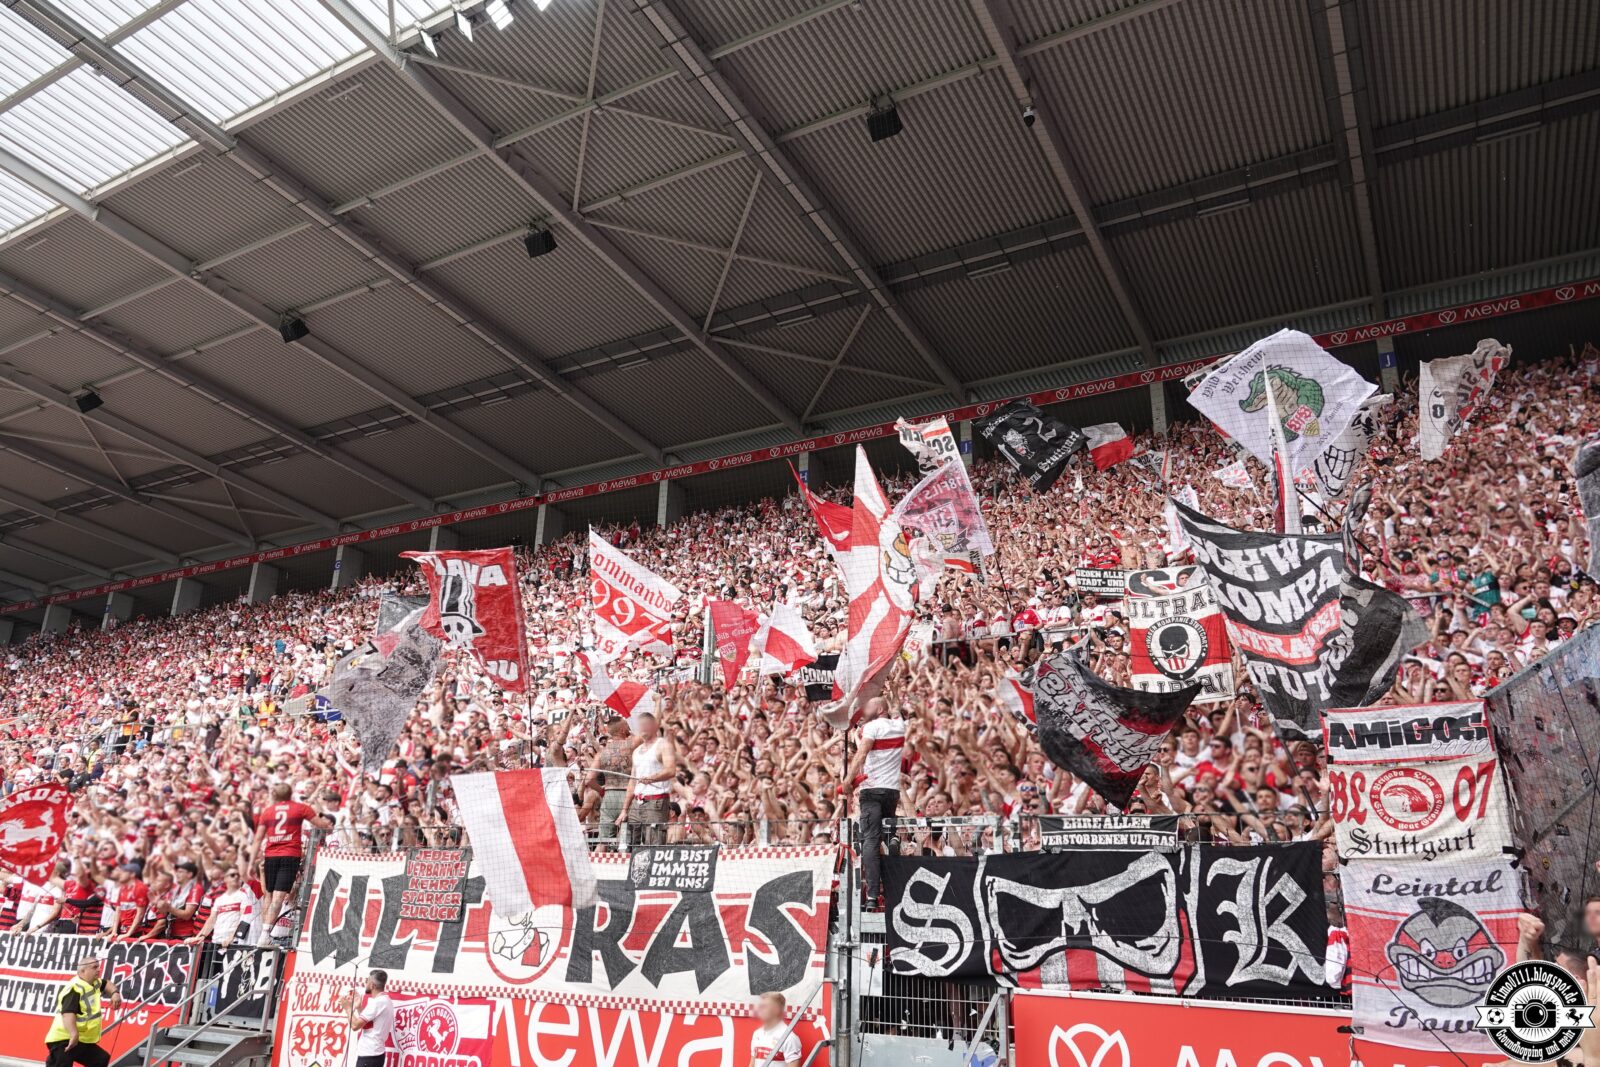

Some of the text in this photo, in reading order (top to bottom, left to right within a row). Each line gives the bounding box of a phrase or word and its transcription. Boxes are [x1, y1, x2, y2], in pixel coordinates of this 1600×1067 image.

[335, 561, 341, 569] G
[593, 553, 673, 614] ommando
[1452, 759, 1497, 823] 07
[275, 811, 288, 834] 2
[1062, 817, 1152, 830] EHRE ALLEN
[1041, 834, 1175, 846] VERSTORBENEN ULTRAS
[1345, 827, 1476, 862] Stuttgart
[416, 850, 463, 861] JEDER
[654, 849, 712, 862] DU BIST
[651, 862, 709, 877] IMMER
[409, 877, 459, 891] KEHRT
[649, 876, 710, 889] BEI UNS!
